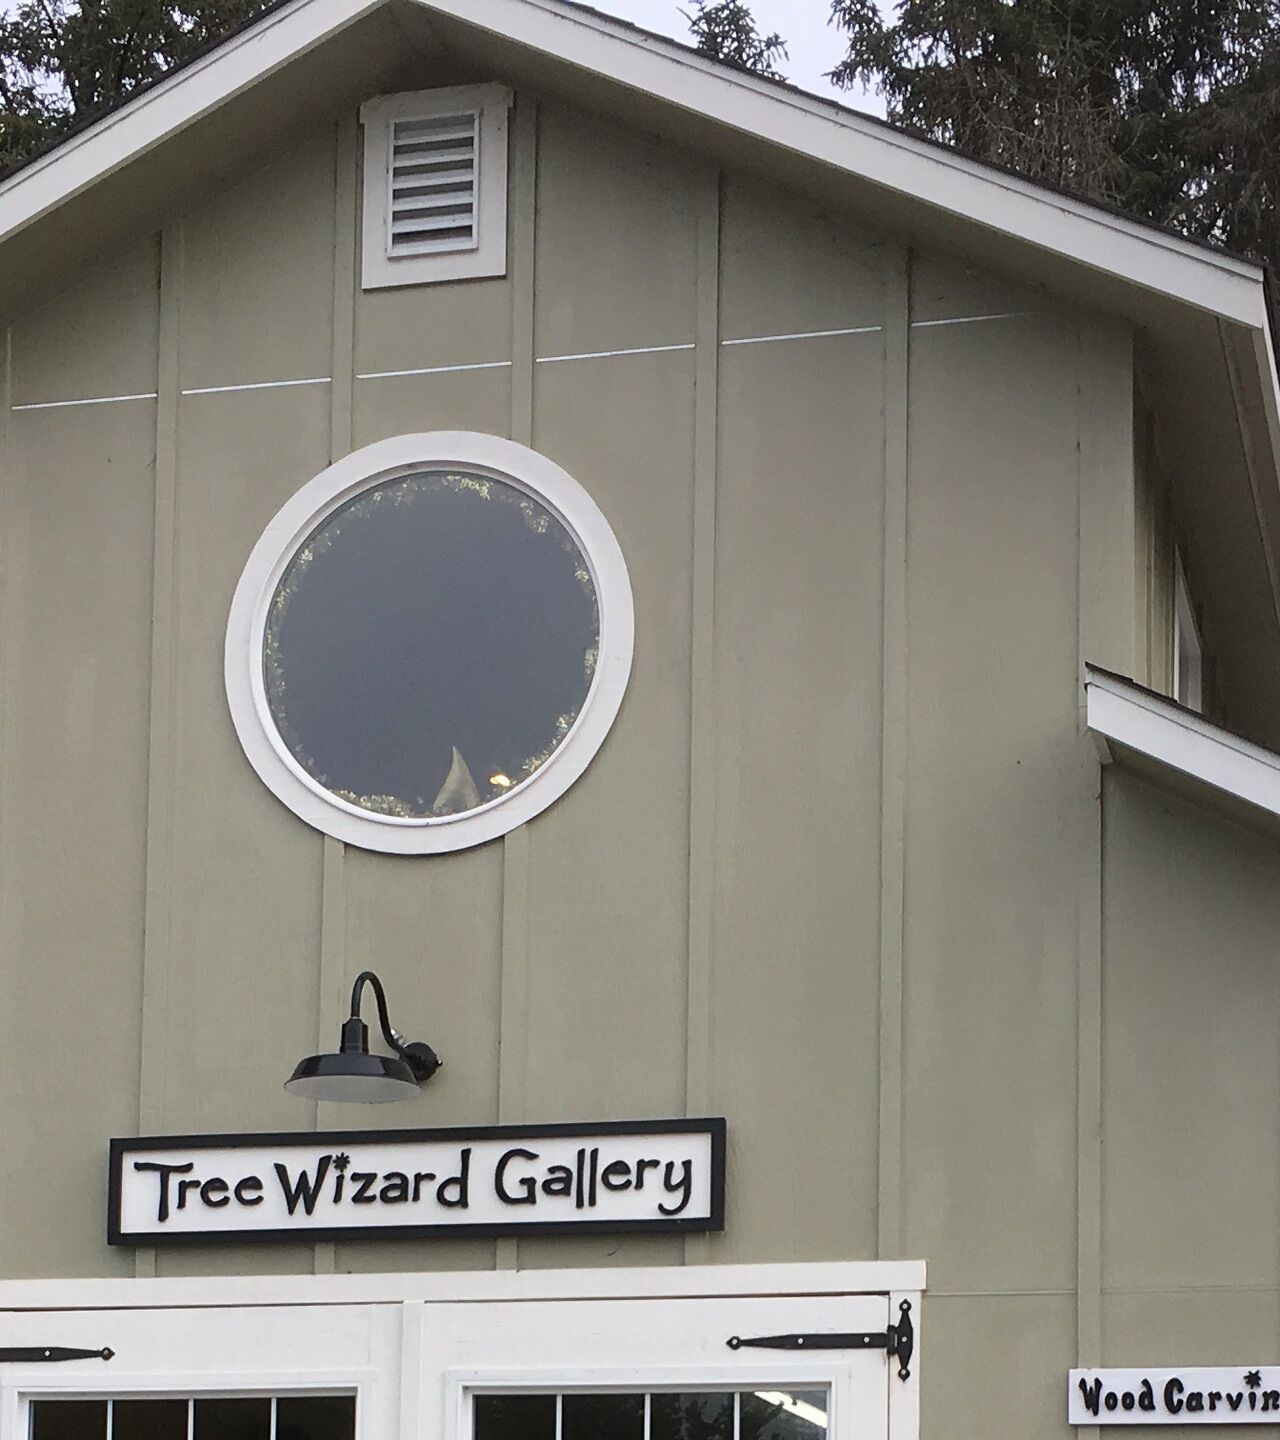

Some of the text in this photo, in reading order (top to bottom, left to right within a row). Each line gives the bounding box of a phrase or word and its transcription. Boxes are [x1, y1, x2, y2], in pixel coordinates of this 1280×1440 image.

[133, 1147, 694, 1223] Tree Wizard Gallery
[1078, 1377, 1156, 1417] Wood
